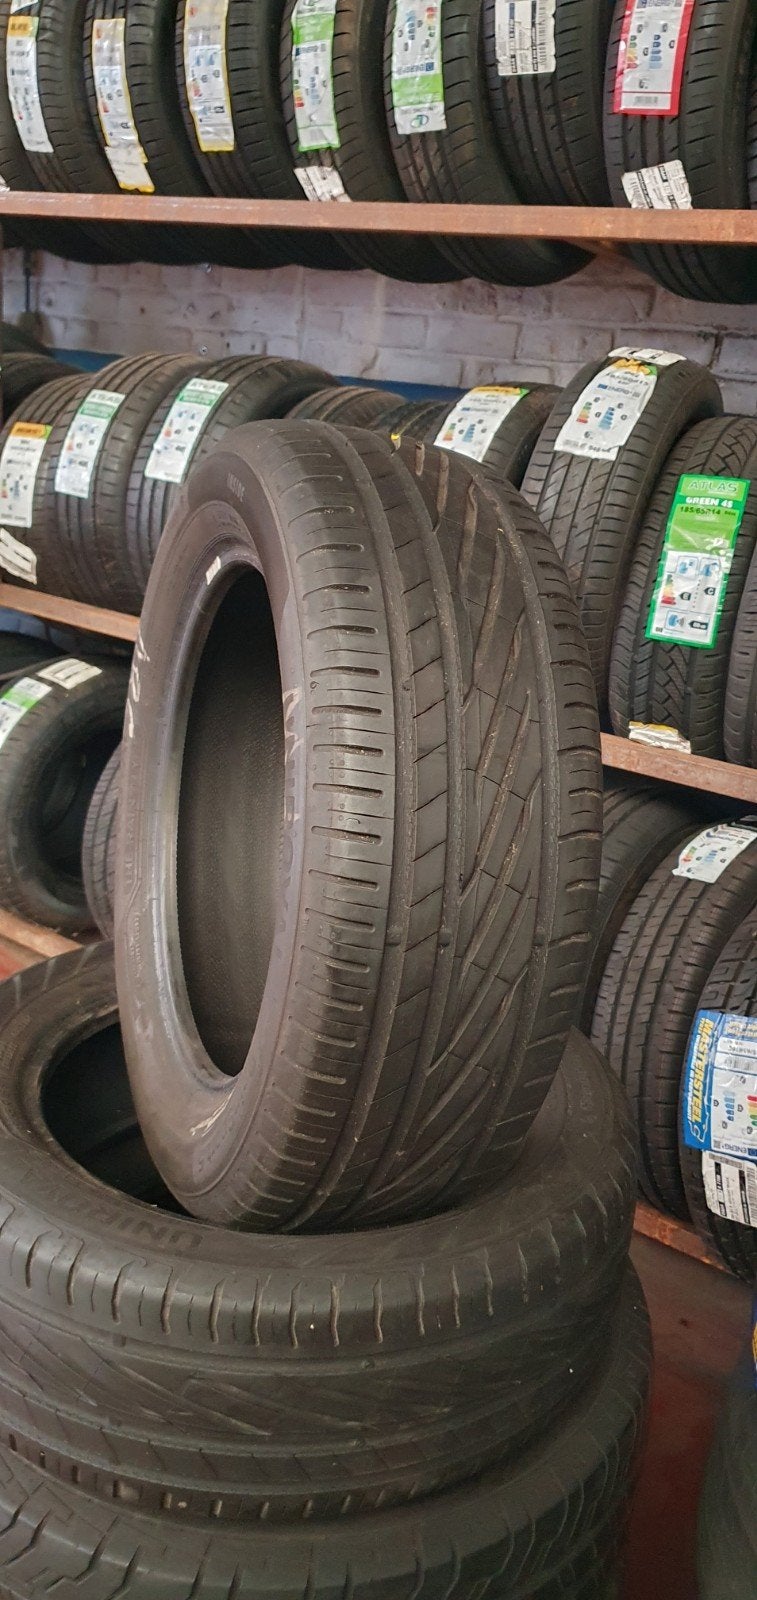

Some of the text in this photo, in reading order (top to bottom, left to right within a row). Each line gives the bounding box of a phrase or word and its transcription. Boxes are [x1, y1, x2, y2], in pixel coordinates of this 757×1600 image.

[688, 480, 738, 492] ATLAS
[685, 496, 720, 506] GREEN
[691, 1018, 714, 1123] MASTERSTEEL
